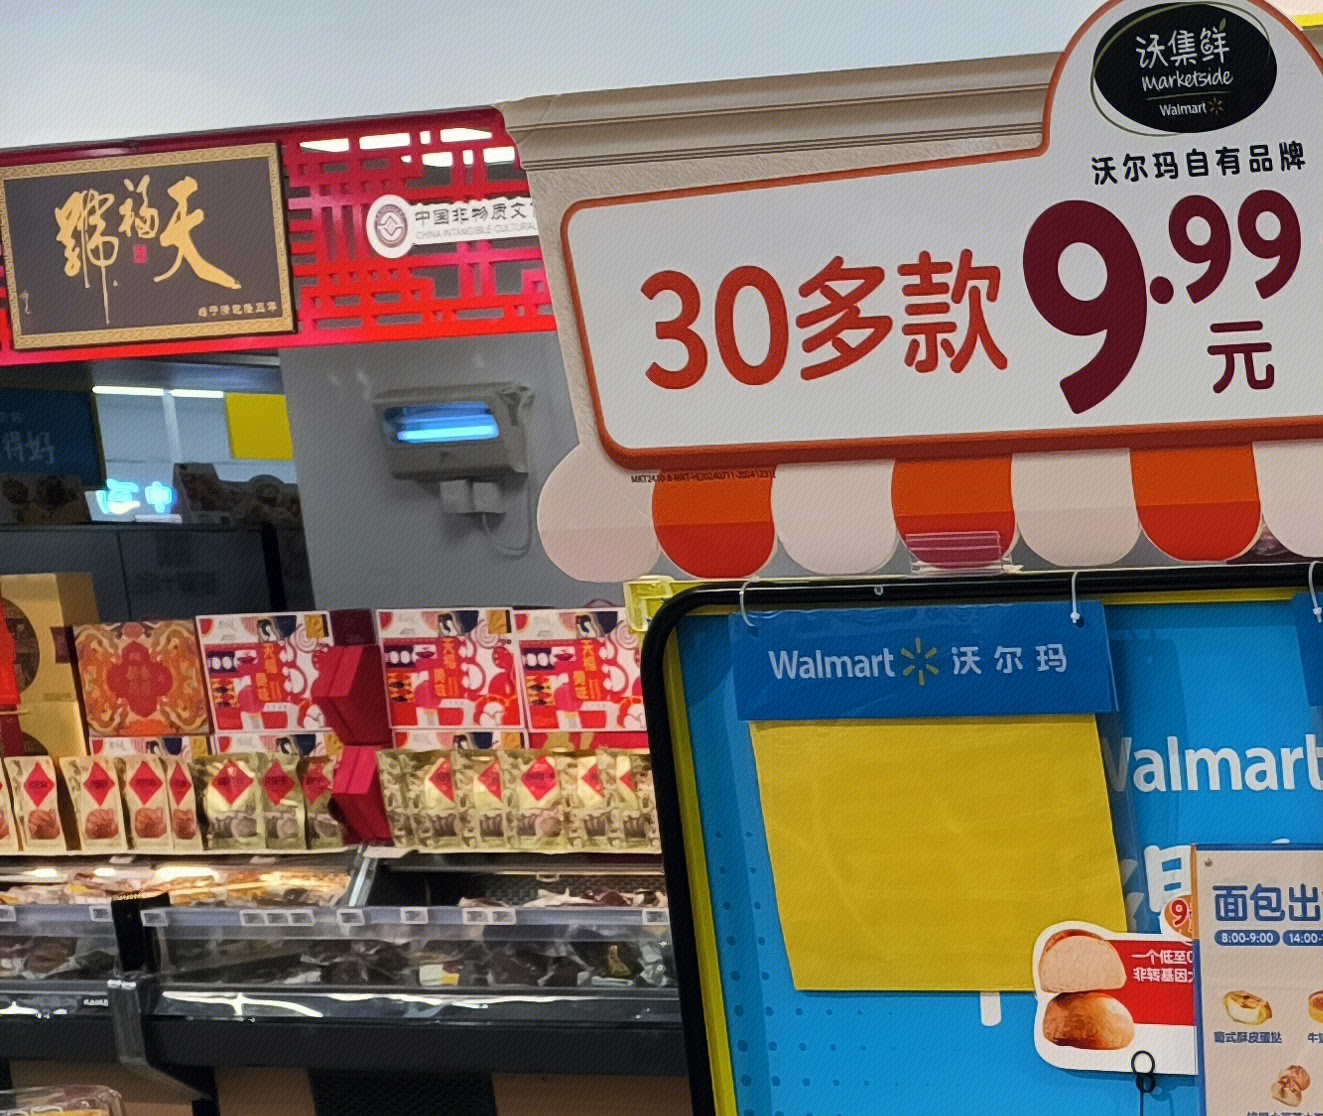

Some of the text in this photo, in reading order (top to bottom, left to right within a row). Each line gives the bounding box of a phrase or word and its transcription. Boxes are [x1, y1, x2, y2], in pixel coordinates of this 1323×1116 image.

[1135, 27, 1230, 69] 沃集鲜
[1142, 68, 1234, 92] Marketside
[1160, 101, 1208, 117] Walmart
[1091, 141, 1306, 185] 沃尔玛自有品牌
[415, 202, 534, 226] 中国非物质文
[640, 248, 1008, 390] 30多款
[1022, 189, 1302, 414] 9.99
[1206, 320, 1275, 394] 元
[769, 644, 1067, 680] Walmart 沃尔玛
[1221, 933, 1274, 944] 8:00-9:00
